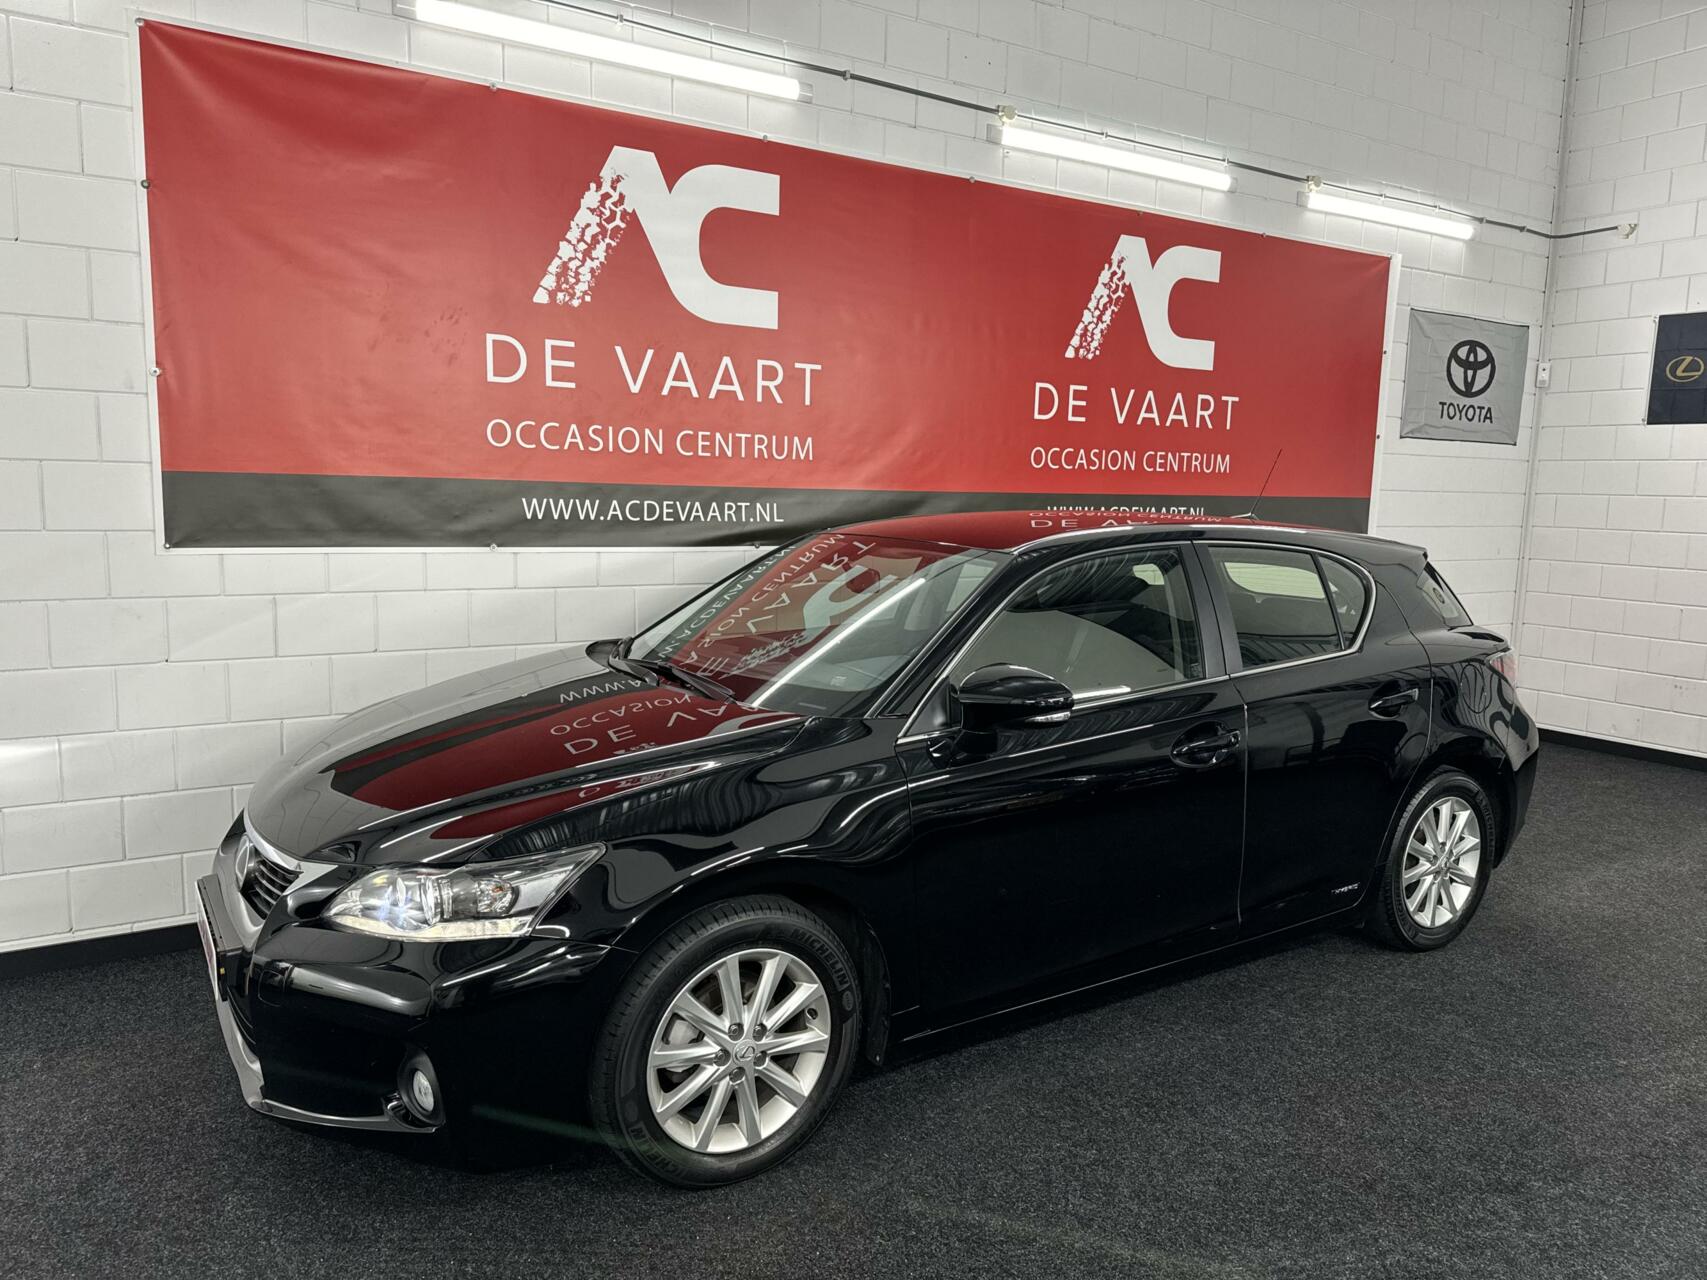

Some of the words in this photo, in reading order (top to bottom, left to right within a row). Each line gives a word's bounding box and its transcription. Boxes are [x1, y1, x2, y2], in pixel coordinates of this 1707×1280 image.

[485, 332, 577, 389] DE
[614, 345, 822, 406] VAART
[1033, 382, 1088, 422] DE
[1110, 387, 1240, 430] VAART
[1439, 401, 1493, 424] TOYOTA
[486, 418, 663, 455] OCCASION
[675, 429, 814, 461] CENTRUM
[1030, 446, 1136, 471] OCCASION
[1142, 451, 1231, 474] CENTRUM
[521, 497, 785, 523] WWW.ACDEVAART.NL
